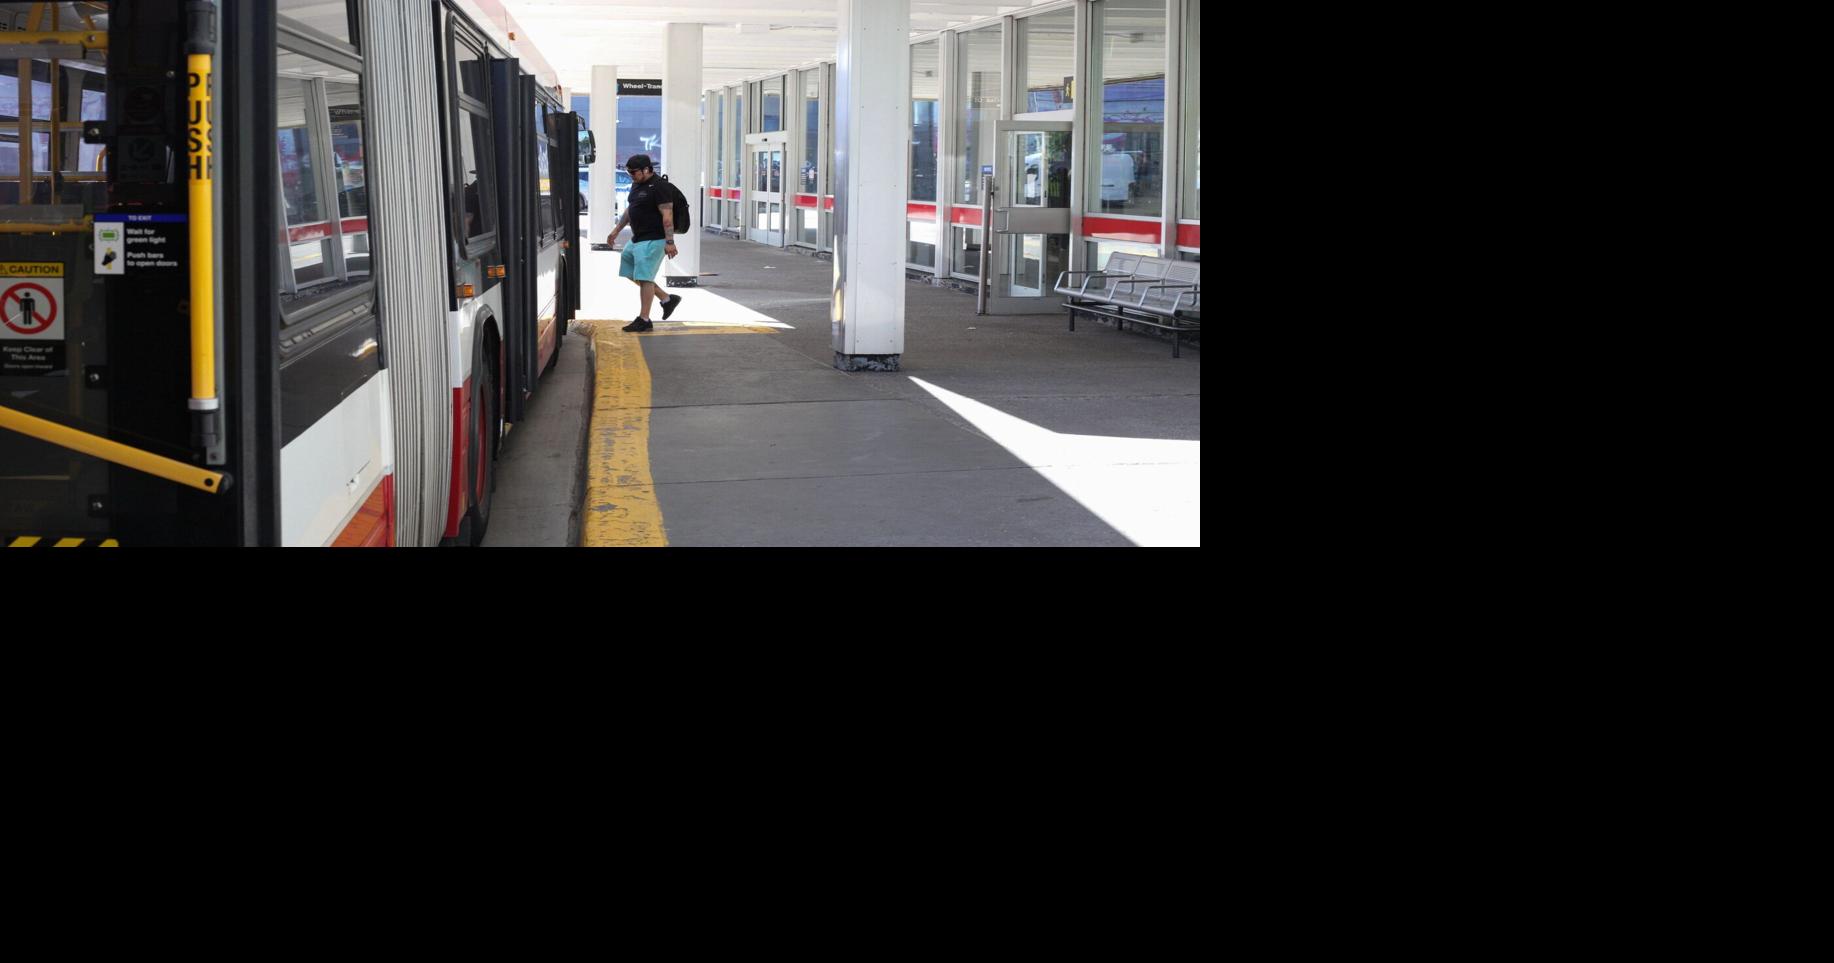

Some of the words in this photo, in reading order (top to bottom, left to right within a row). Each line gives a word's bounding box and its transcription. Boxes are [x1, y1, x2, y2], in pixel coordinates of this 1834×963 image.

[126, 237, 148, 245] green
[149, 236, 166, 245] light
[9, 265, 59, 274] CAUTION
